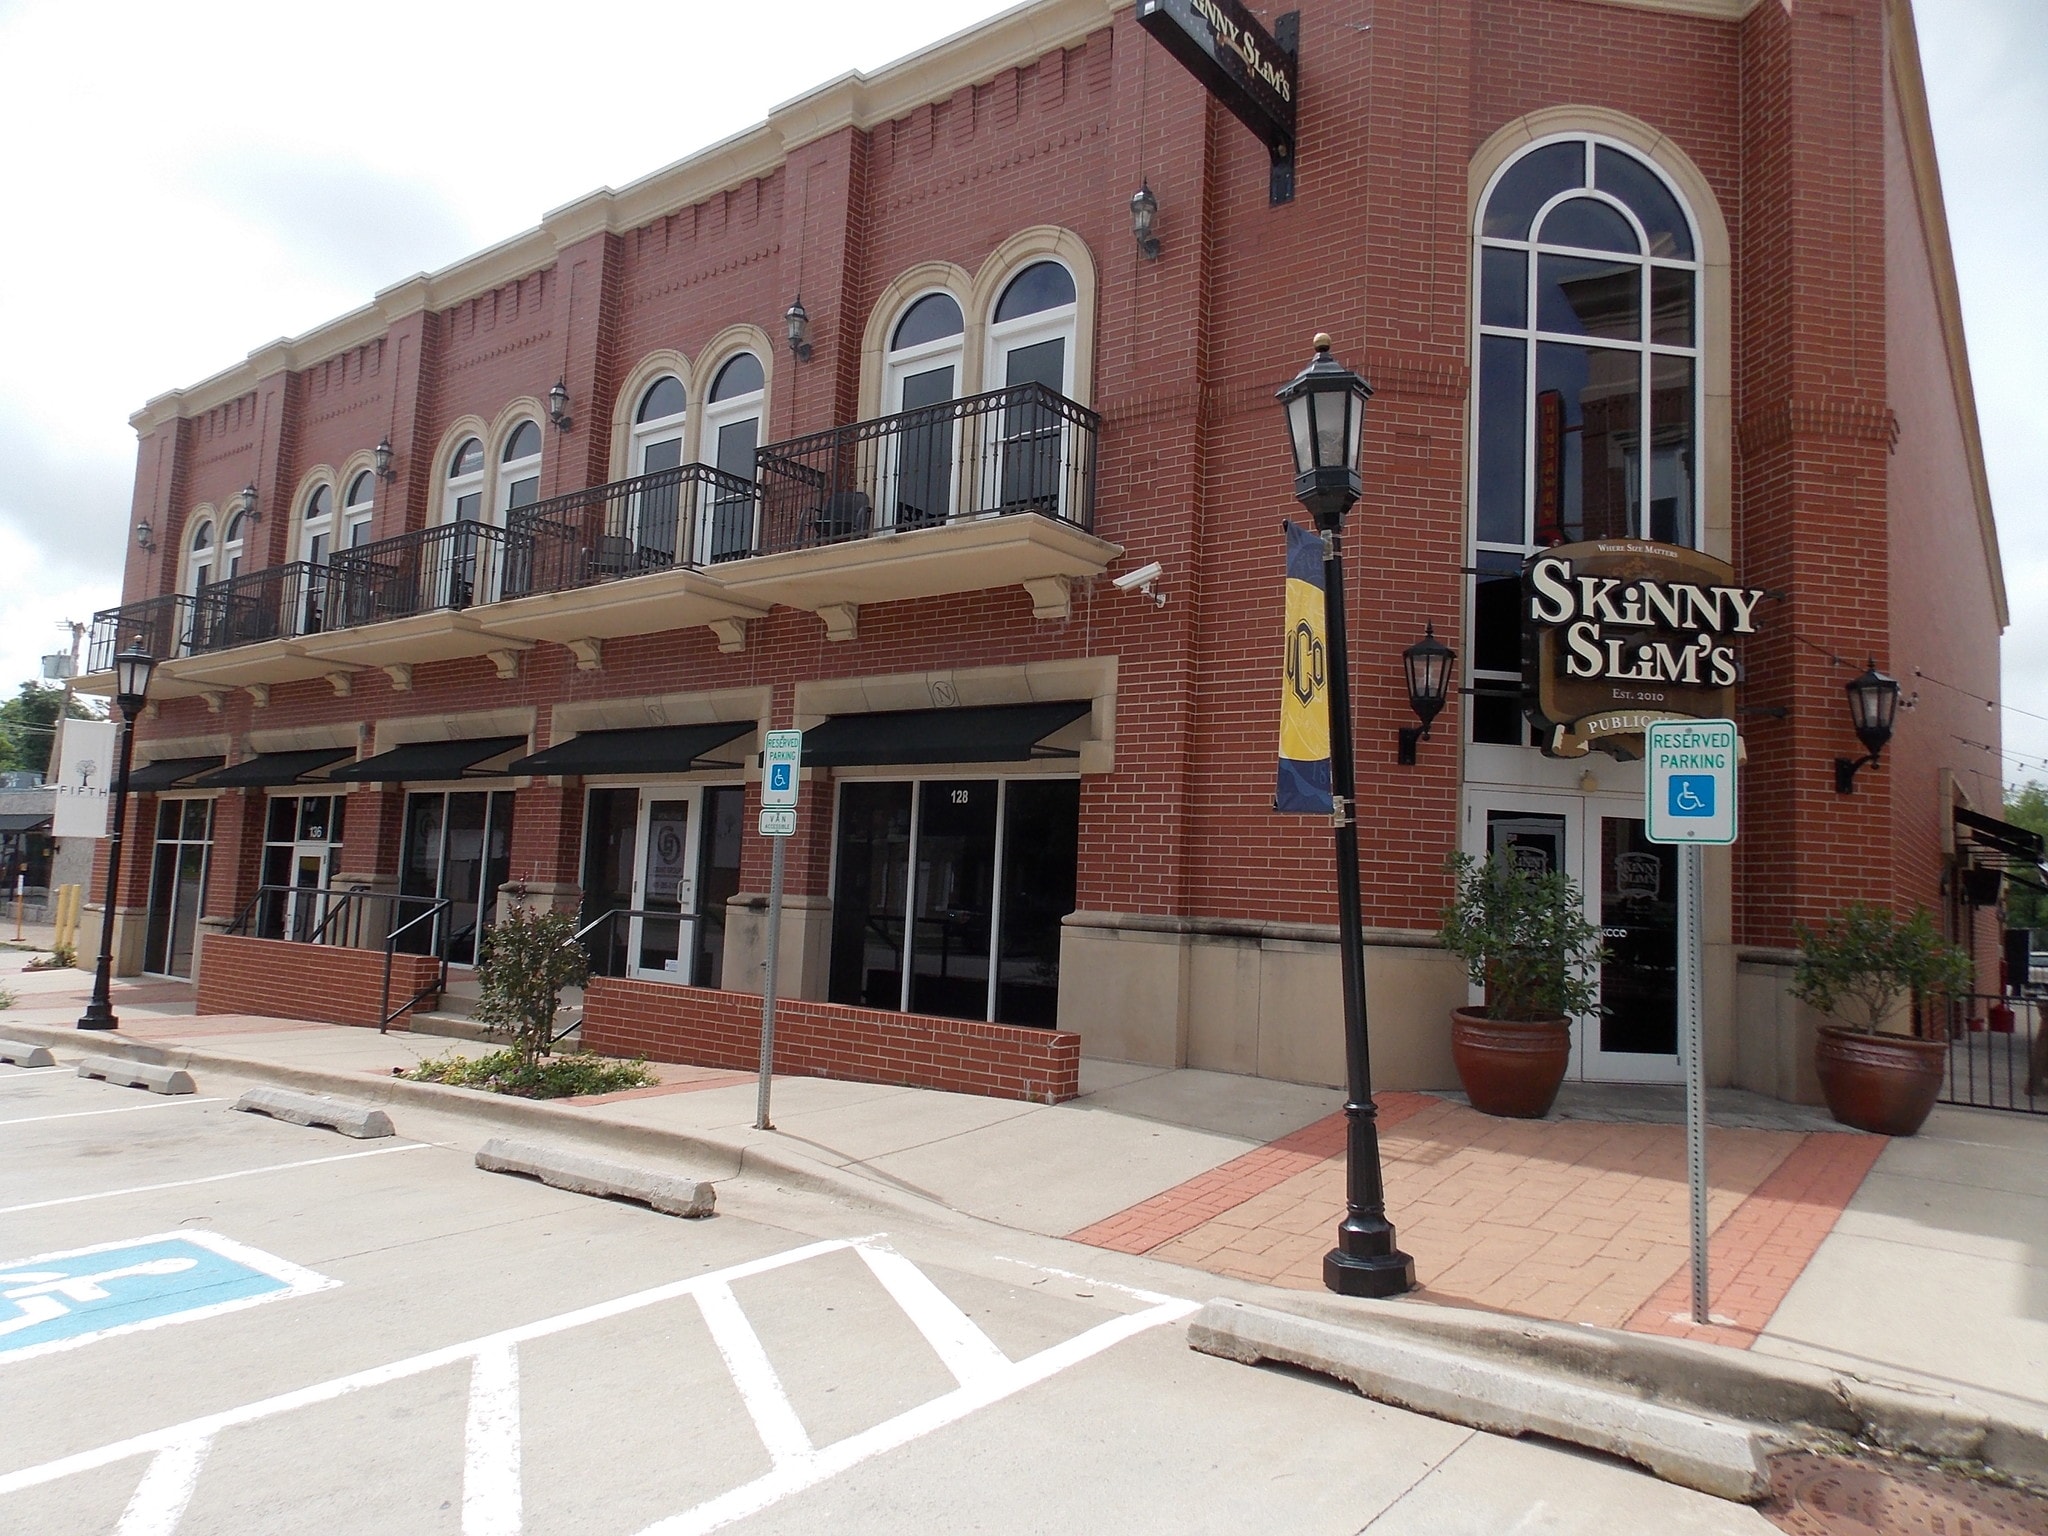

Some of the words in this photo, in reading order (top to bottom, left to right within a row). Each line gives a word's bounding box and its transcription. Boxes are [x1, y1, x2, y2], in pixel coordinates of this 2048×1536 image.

[1637, 692, 1665, 702] 2010
[1587, 715, 1651, 734] PUBLIC
[767, 738, 799, 749] RESERVED
[1653, 733, 1730, 749] RESERVED
[769, 751, 796, 761] PARKING
[1660, 754, 1725, 769] PARKING
[59, 785, 108, 797] FIFTH
[950, 789, 969, 804] 128
[769, 815, 787, 823] VAN
[309, 826, 323, 838] 136
